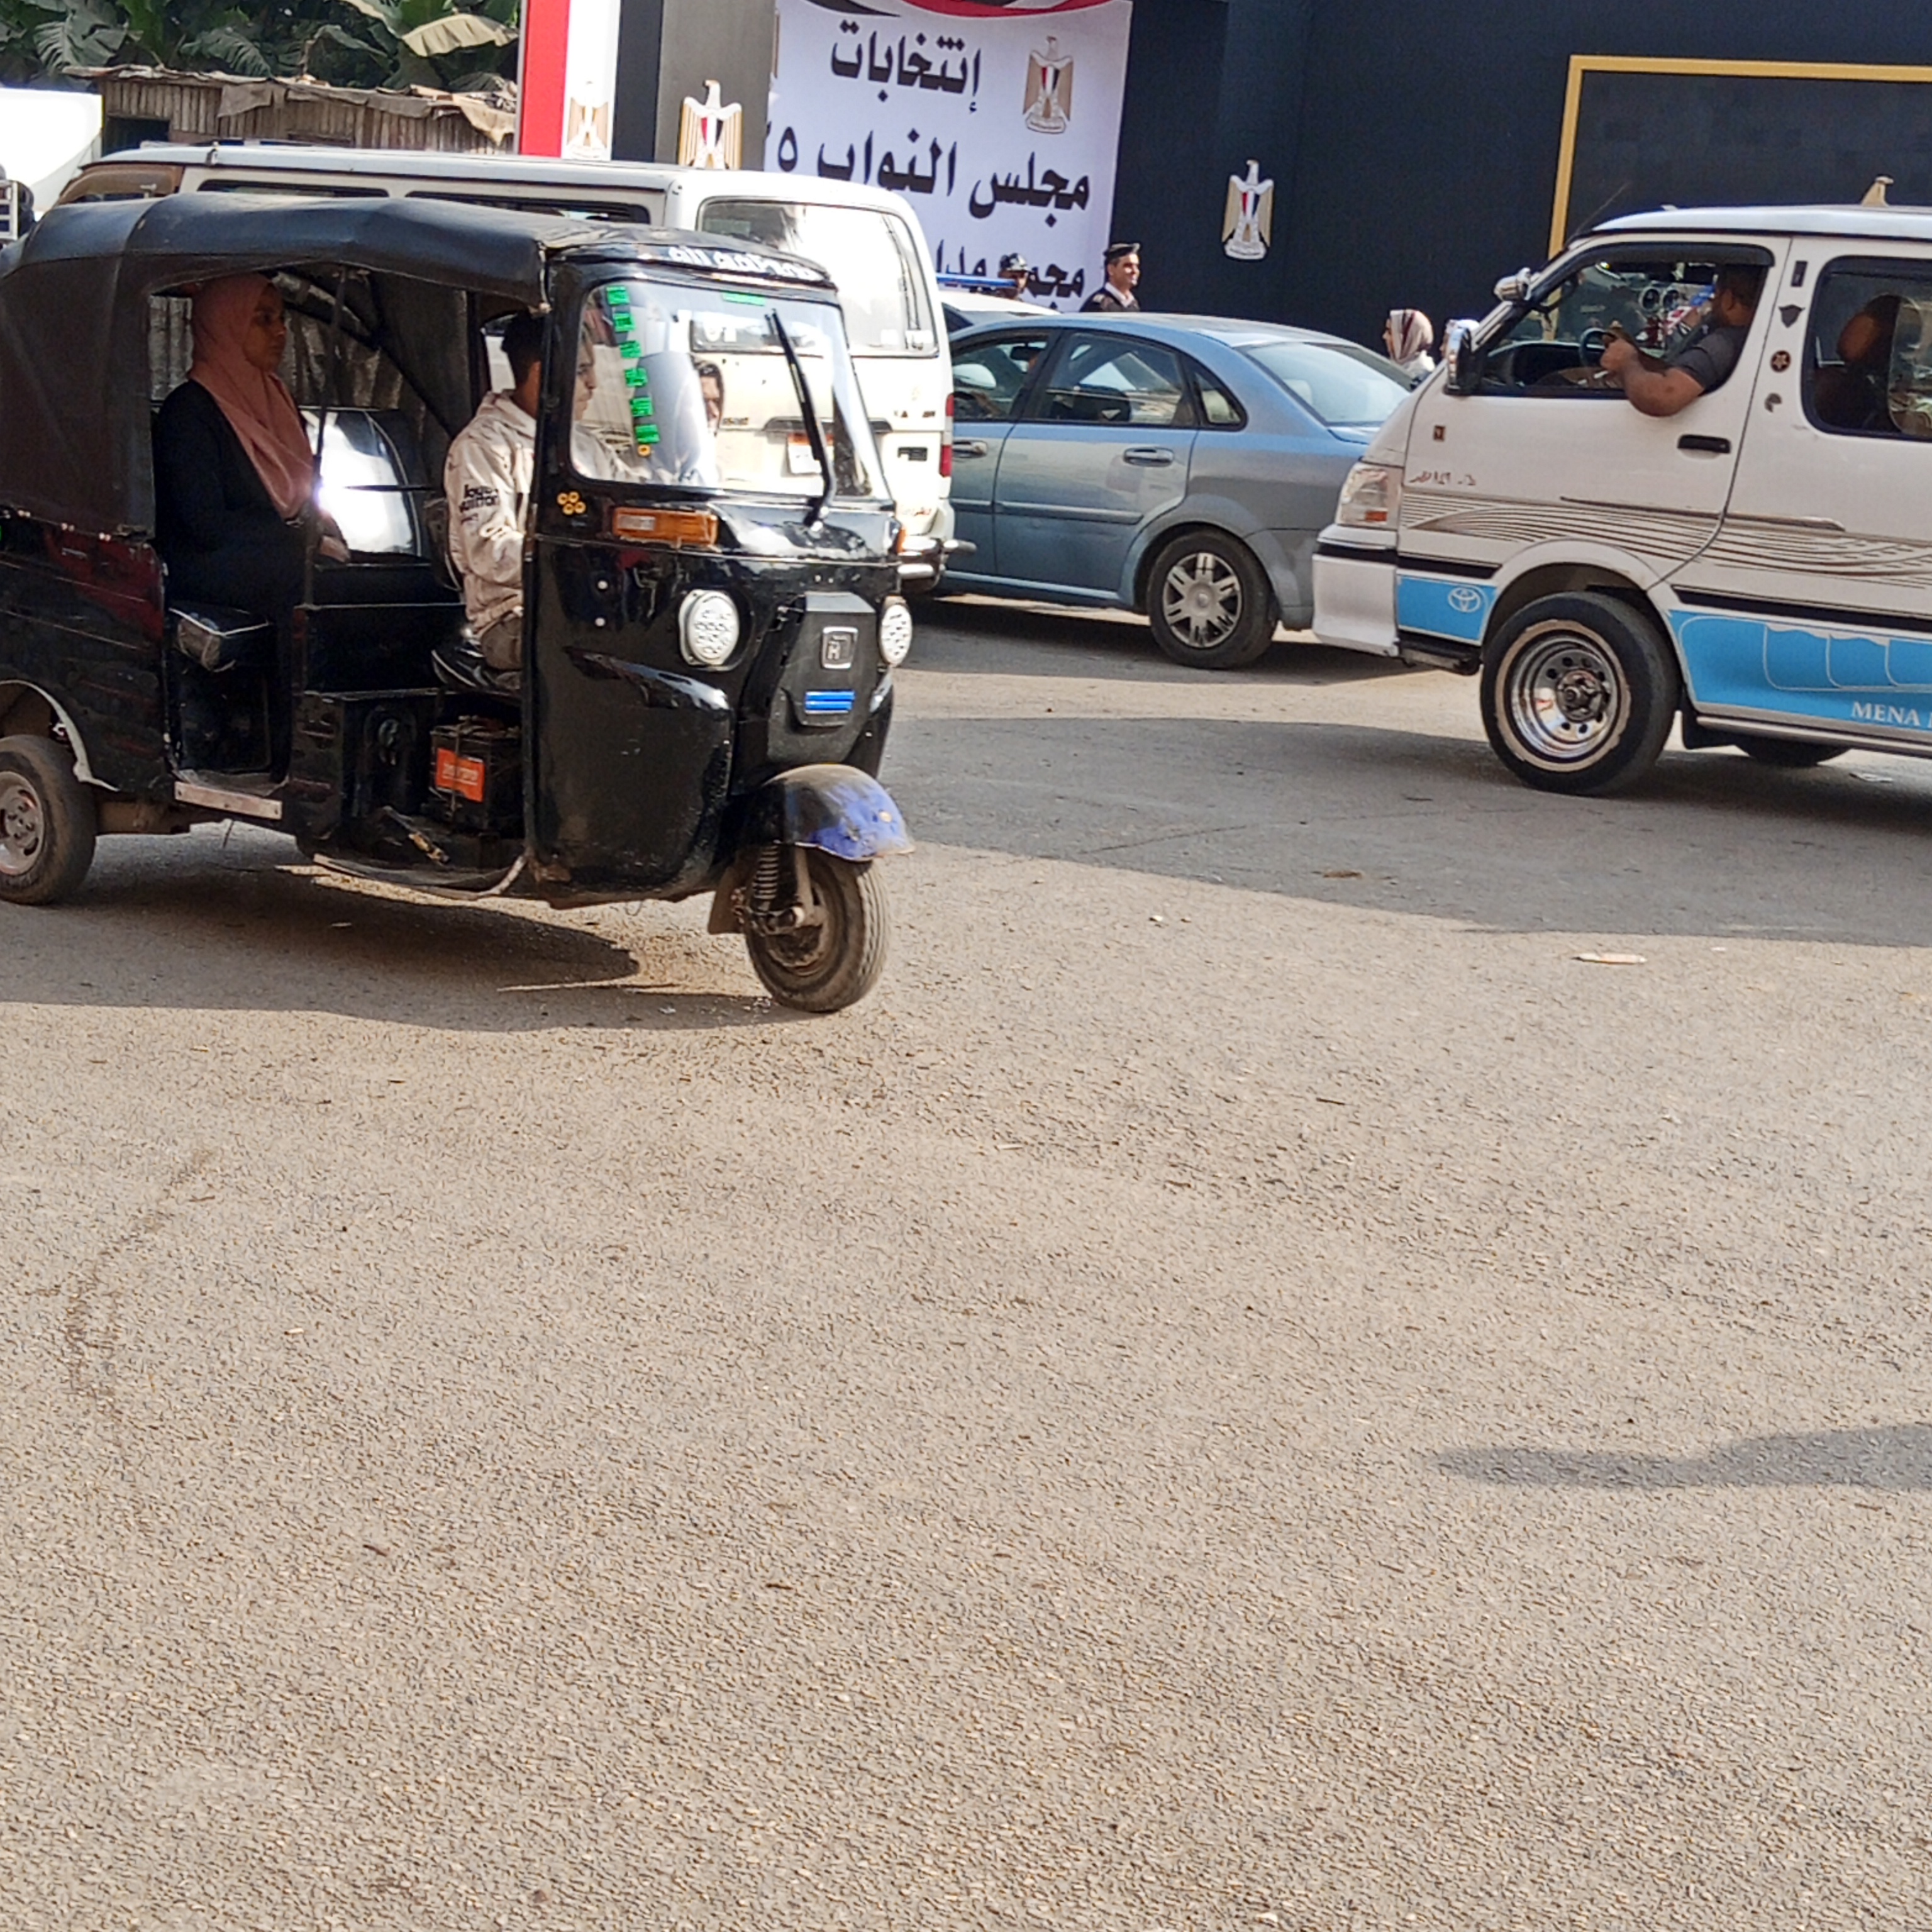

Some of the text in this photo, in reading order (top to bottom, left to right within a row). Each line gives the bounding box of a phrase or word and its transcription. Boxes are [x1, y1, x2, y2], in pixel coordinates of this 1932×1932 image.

[830, 21, 981, 113] إنتخابات
[765, 121, 1090, 227] مجلس النواب ٥
[1851, 701, 1921, 728] MENA
